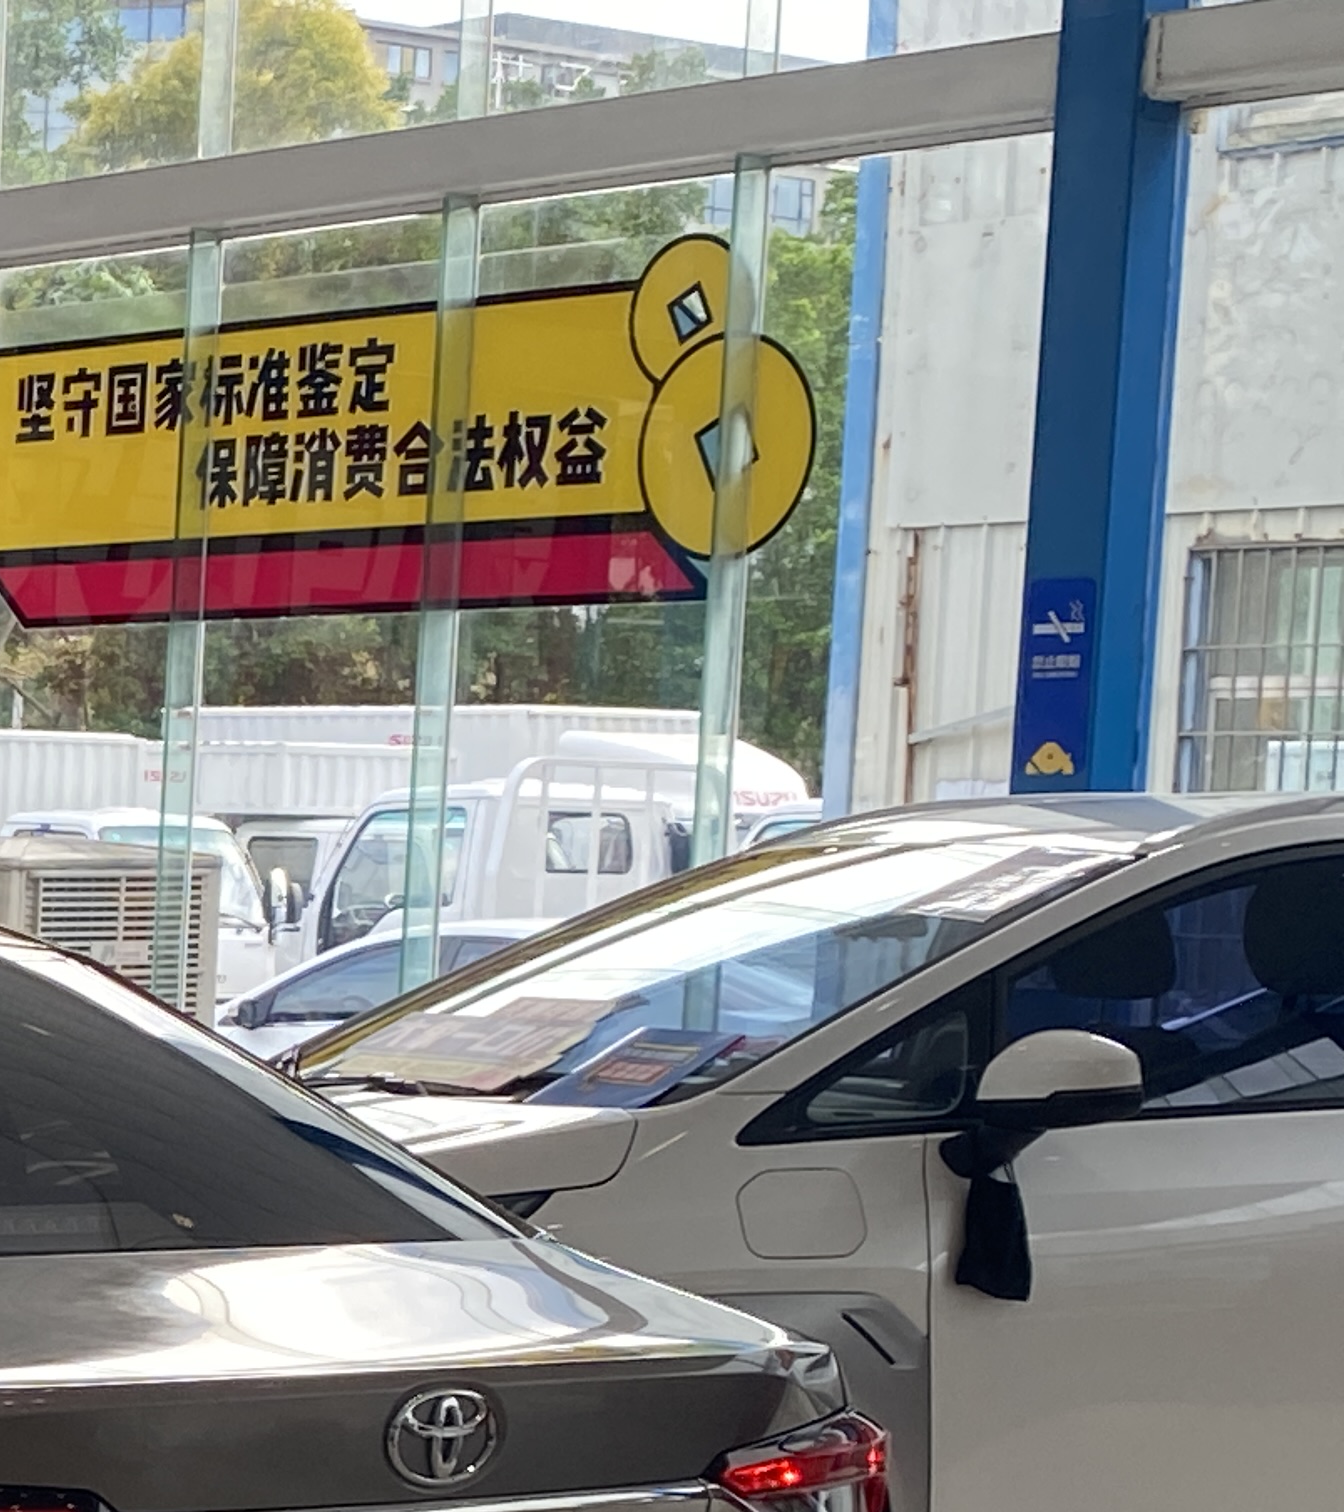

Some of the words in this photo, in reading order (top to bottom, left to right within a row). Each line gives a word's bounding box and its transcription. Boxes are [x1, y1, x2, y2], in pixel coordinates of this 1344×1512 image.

[15, 338, 397, 444] 坚守国家标准鉴定
[195, 407, 608, 510] 保障消费合法权益
